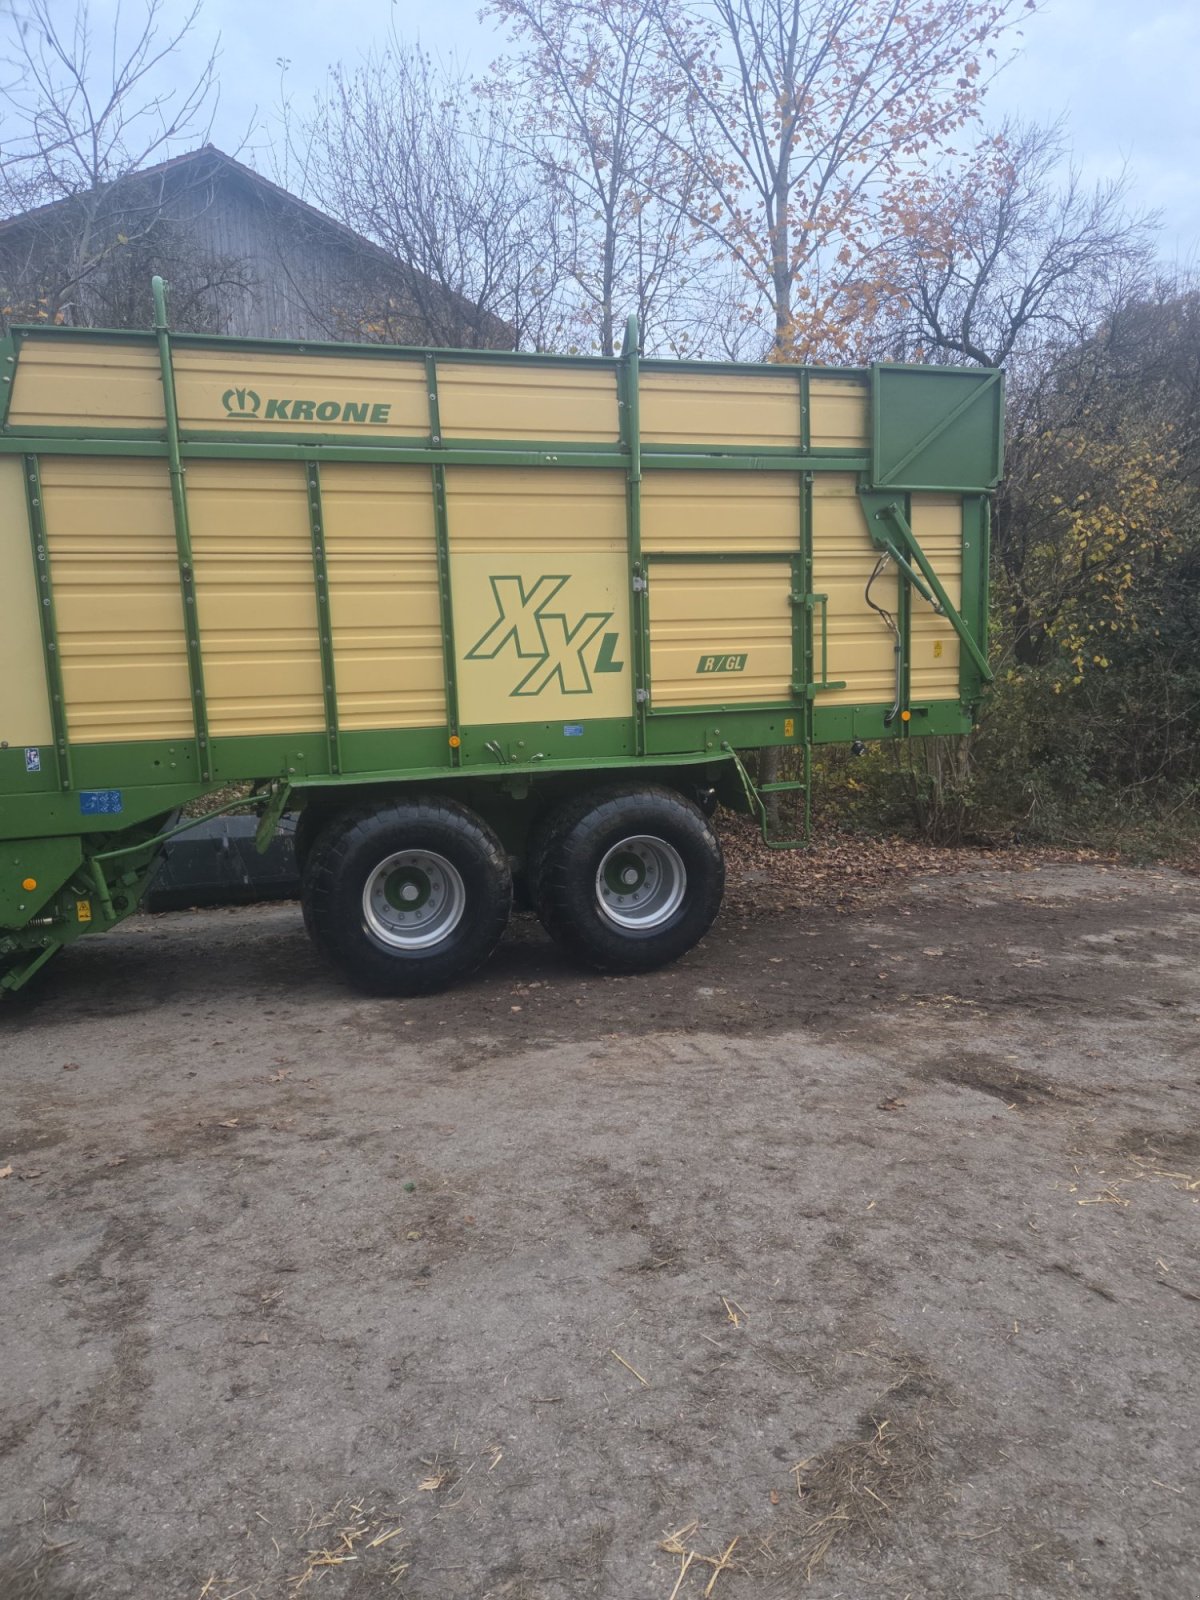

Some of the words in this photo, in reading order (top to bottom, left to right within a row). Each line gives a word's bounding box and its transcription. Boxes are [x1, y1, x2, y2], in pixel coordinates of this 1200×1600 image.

[265, 399, 392, 424] KRONE
[463, 575, 624, 697] XXL
[704, 656, 741, 671] R/GL
